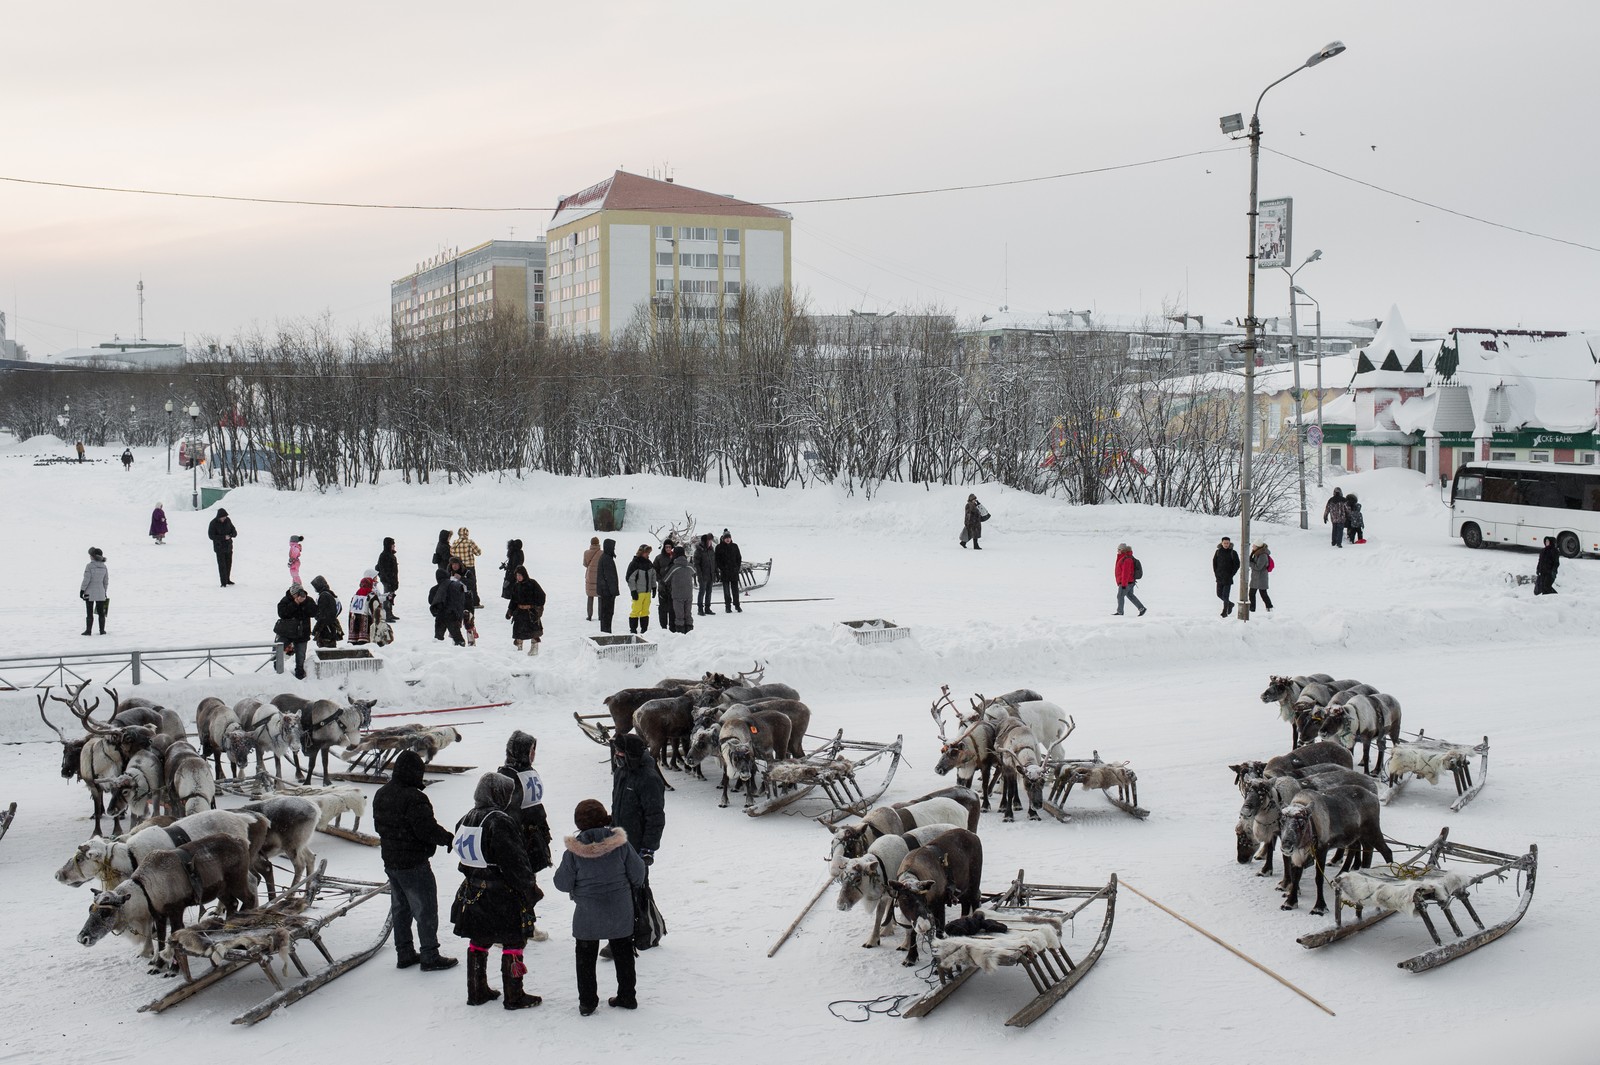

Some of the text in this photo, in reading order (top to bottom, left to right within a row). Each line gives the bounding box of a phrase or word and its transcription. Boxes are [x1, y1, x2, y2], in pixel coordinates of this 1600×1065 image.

[1541, 435, 1573, 443] СКБ-БАНК
[353, 598, 364, 610] 40
[526, 776, 543, 802] 15
[454, 833, 479, 861] 11
